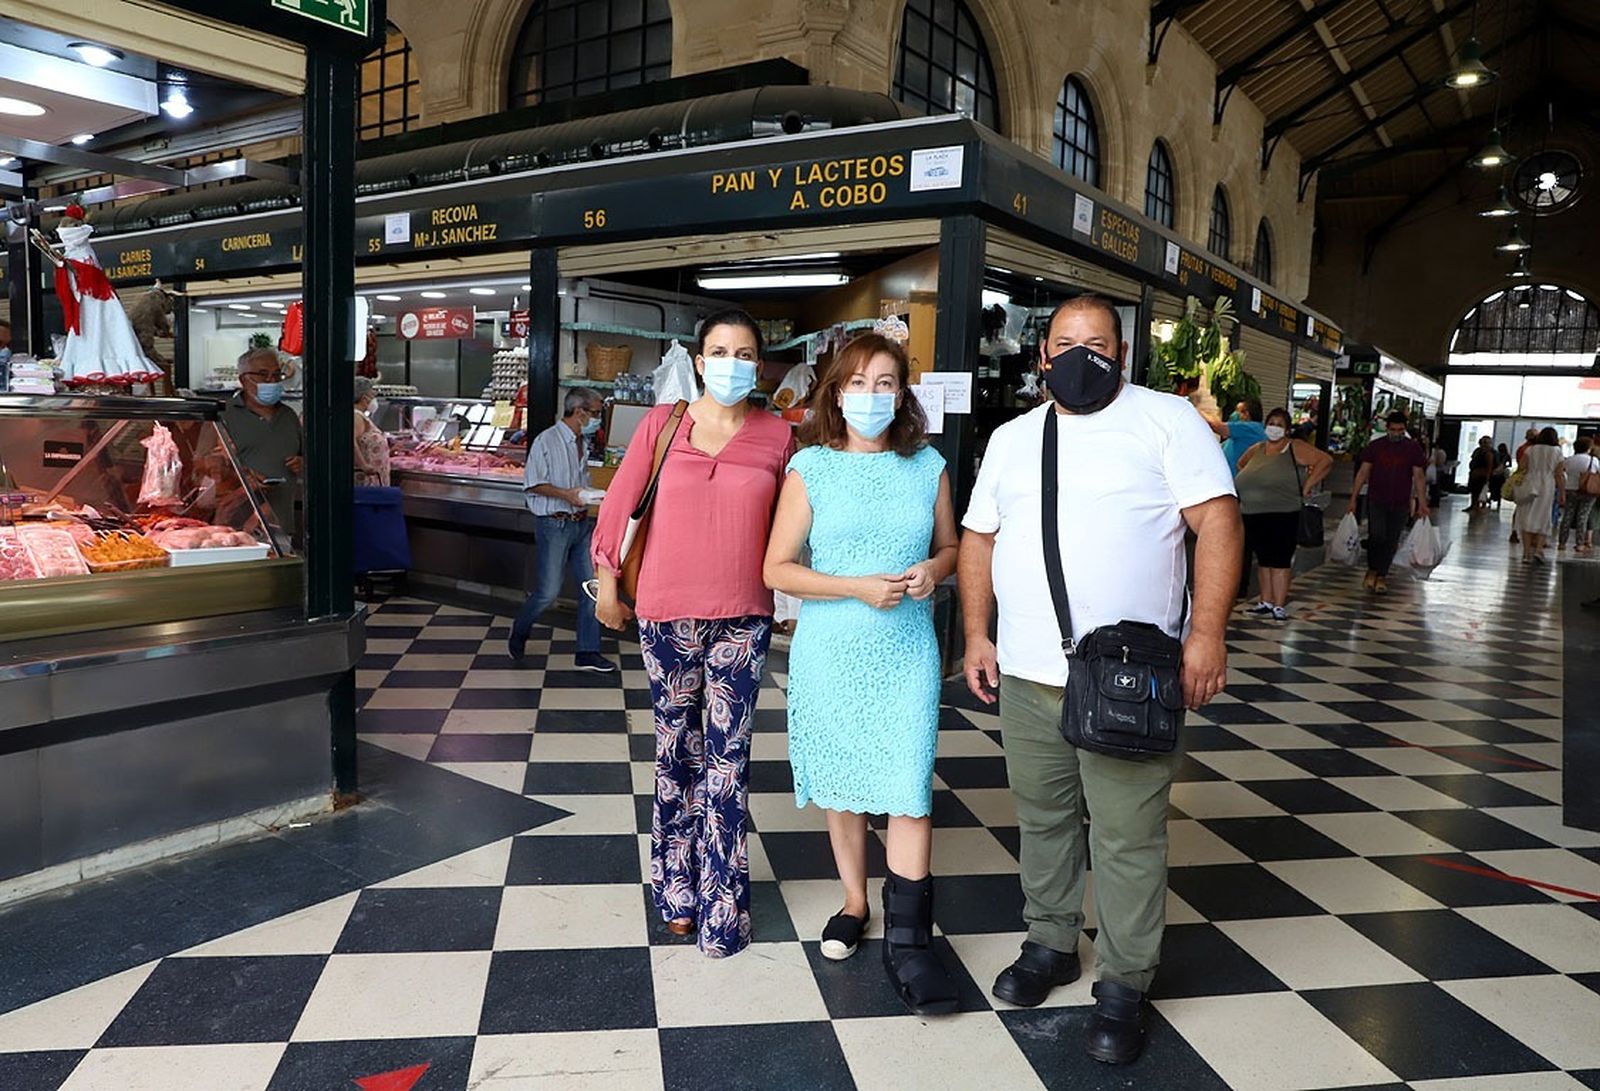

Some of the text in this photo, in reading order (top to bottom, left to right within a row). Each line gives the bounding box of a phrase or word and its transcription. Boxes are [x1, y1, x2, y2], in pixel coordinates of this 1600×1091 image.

[712, 154, 905, 194] PAN Y LACTEOS
[789, 182, 887, 211] A. COBO
[1012, 192, 1028, 216] 41
[431, 203, 479, 226] RECOVA
[584, 209, 606, 229] 56
[430, 229, 440, 247] J.
[441, 223, 497, 245] SANCHEZ
[1101, 209, 1141, 244] ESPECIAS
[221, 232, 272, 252] CARNICERIA
[368, 238, 381, 252] 55
[1101, 231, 1139, 263] GALLEGO
[120, 249, 152, 264] CARNES
[195, 258, 205, 271] 54
